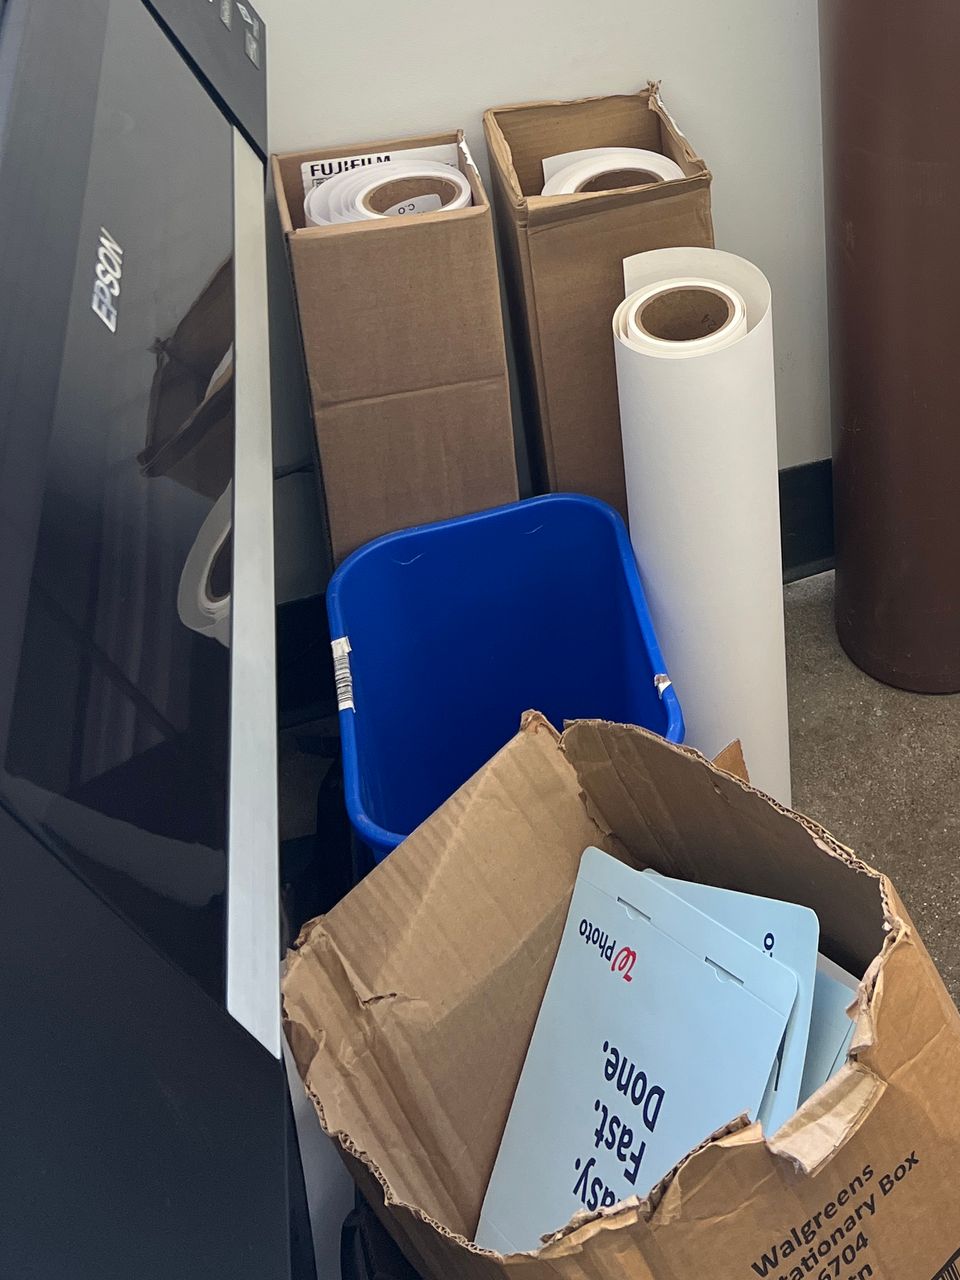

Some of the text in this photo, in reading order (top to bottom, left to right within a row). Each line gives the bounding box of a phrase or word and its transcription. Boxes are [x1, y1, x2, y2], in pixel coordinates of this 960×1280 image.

[92, 226, 123, 333] EPSON
[579, 919, 617, 962] Photo
[602, 1040, 666, 1133] Done.
[572, 1157, 622, 1212] asy.
[594, 1099, 647, 1186] Fast.
[878, 1150, 920, 1197] Box
[751, 1164, 875, 1279] Walgreens
